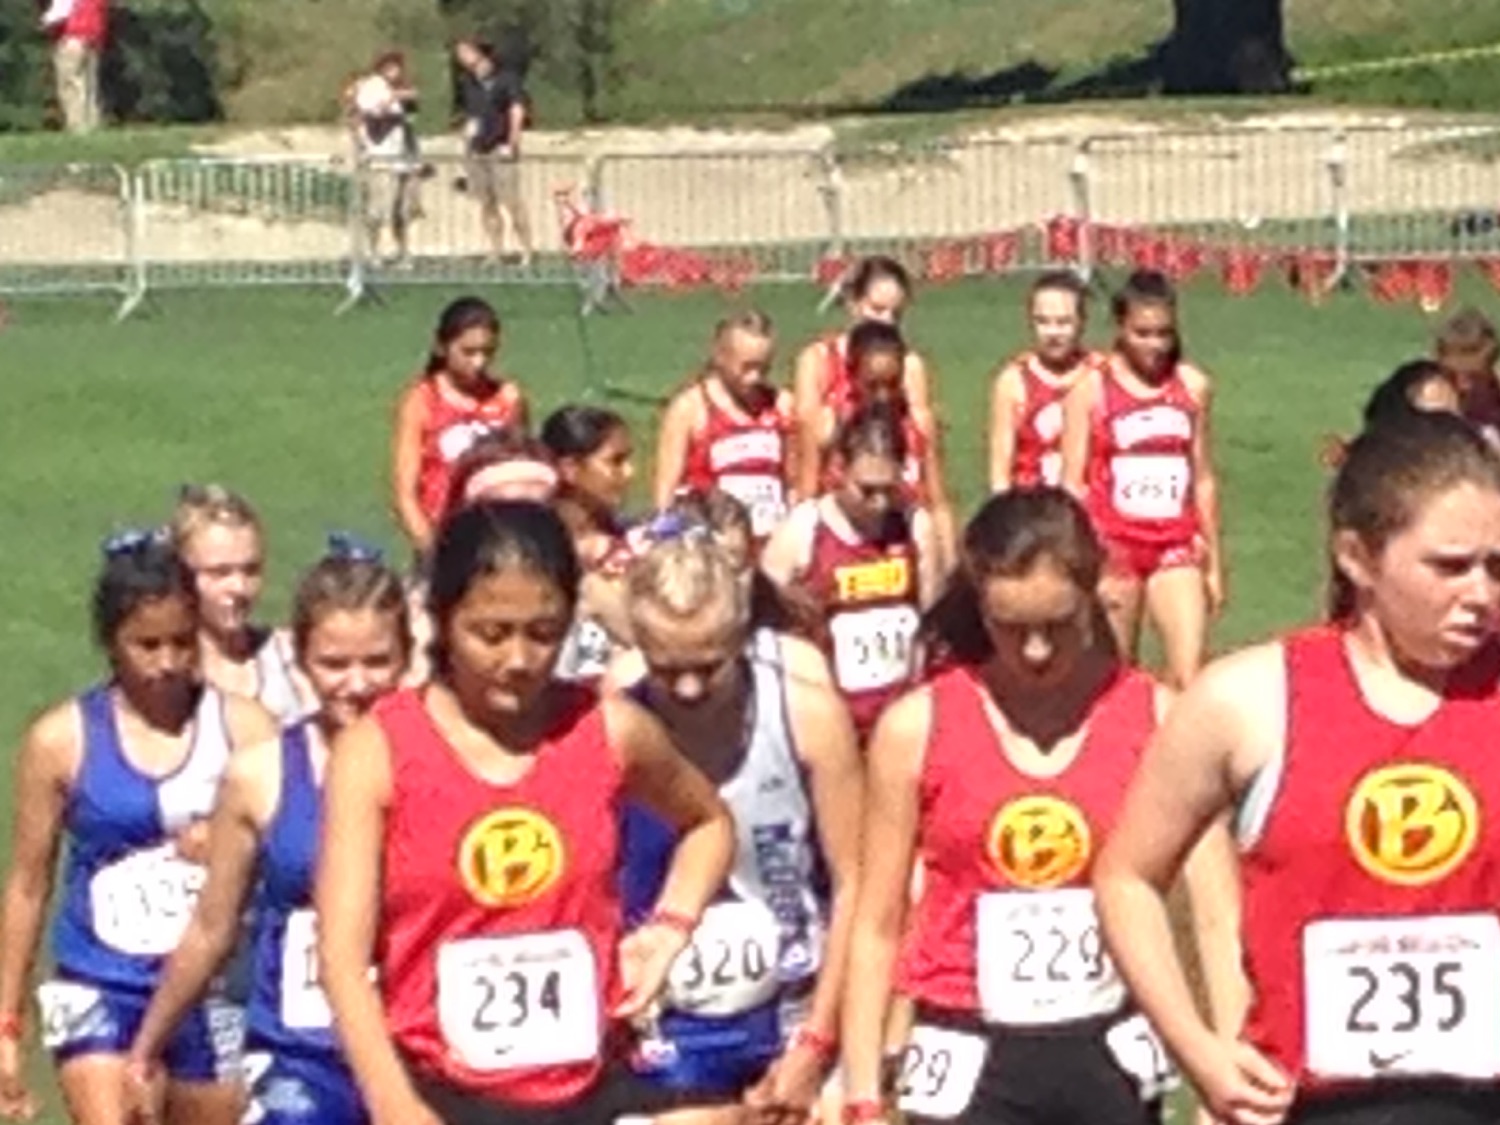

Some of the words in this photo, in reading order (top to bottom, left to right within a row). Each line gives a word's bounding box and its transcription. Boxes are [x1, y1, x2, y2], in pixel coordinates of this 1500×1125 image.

[1365, 780, 1466, 869] B
[1012, 923, 1104, 982] 229
[472, 971, 561, 1031] 234
[1346, 962, 1466, 1032] 235
